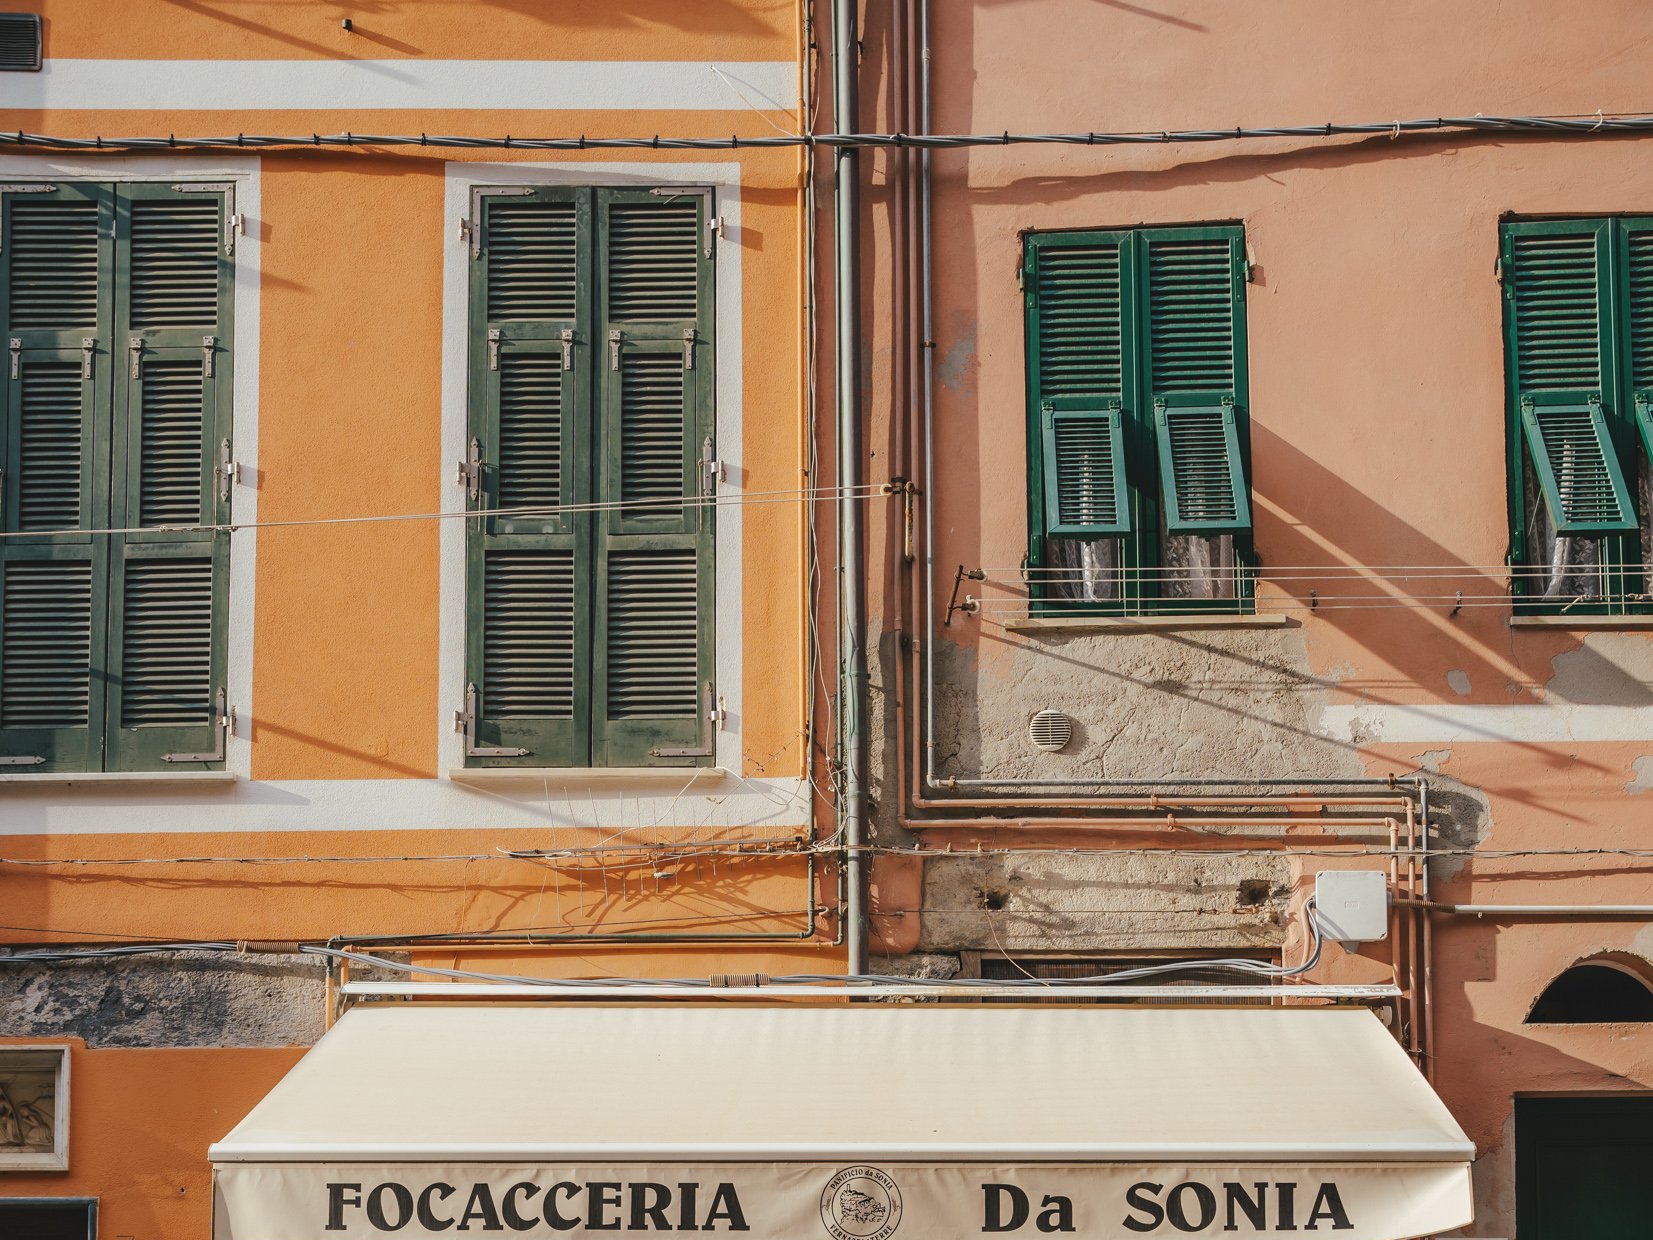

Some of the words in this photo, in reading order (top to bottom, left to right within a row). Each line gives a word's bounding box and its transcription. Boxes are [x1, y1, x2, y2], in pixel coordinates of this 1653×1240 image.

[830, 1169, 864, 1190] PANIFICIO
[864, 1169, 874, 1177] da
[874, 1172, 893, 1191] SONIA
[325, 1181, 750, 1231] FOCACCERIA
[981, 1183, 1076, 1232] Da
[1122, 1181, 1354, 1232] SONIA
